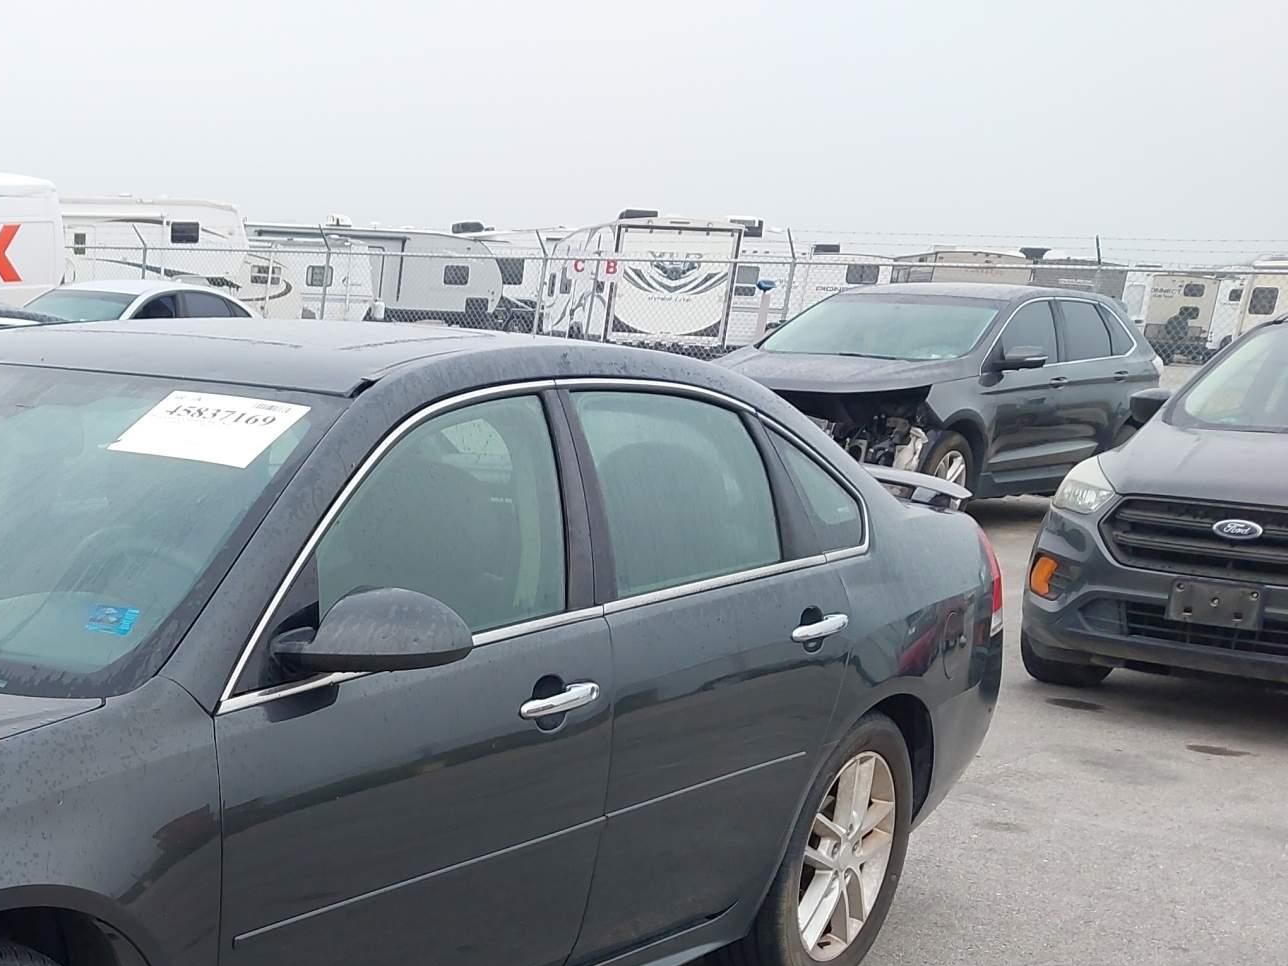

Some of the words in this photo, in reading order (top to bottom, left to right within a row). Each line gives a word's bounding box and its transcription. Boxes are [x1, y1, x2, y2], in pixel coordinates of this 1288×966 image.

[573, 258, 586, 273] C
[605, 258, 618, 275] B
[165, 404, 277, 426] 45837169
[1223, 522, 1252, 535] Ford
